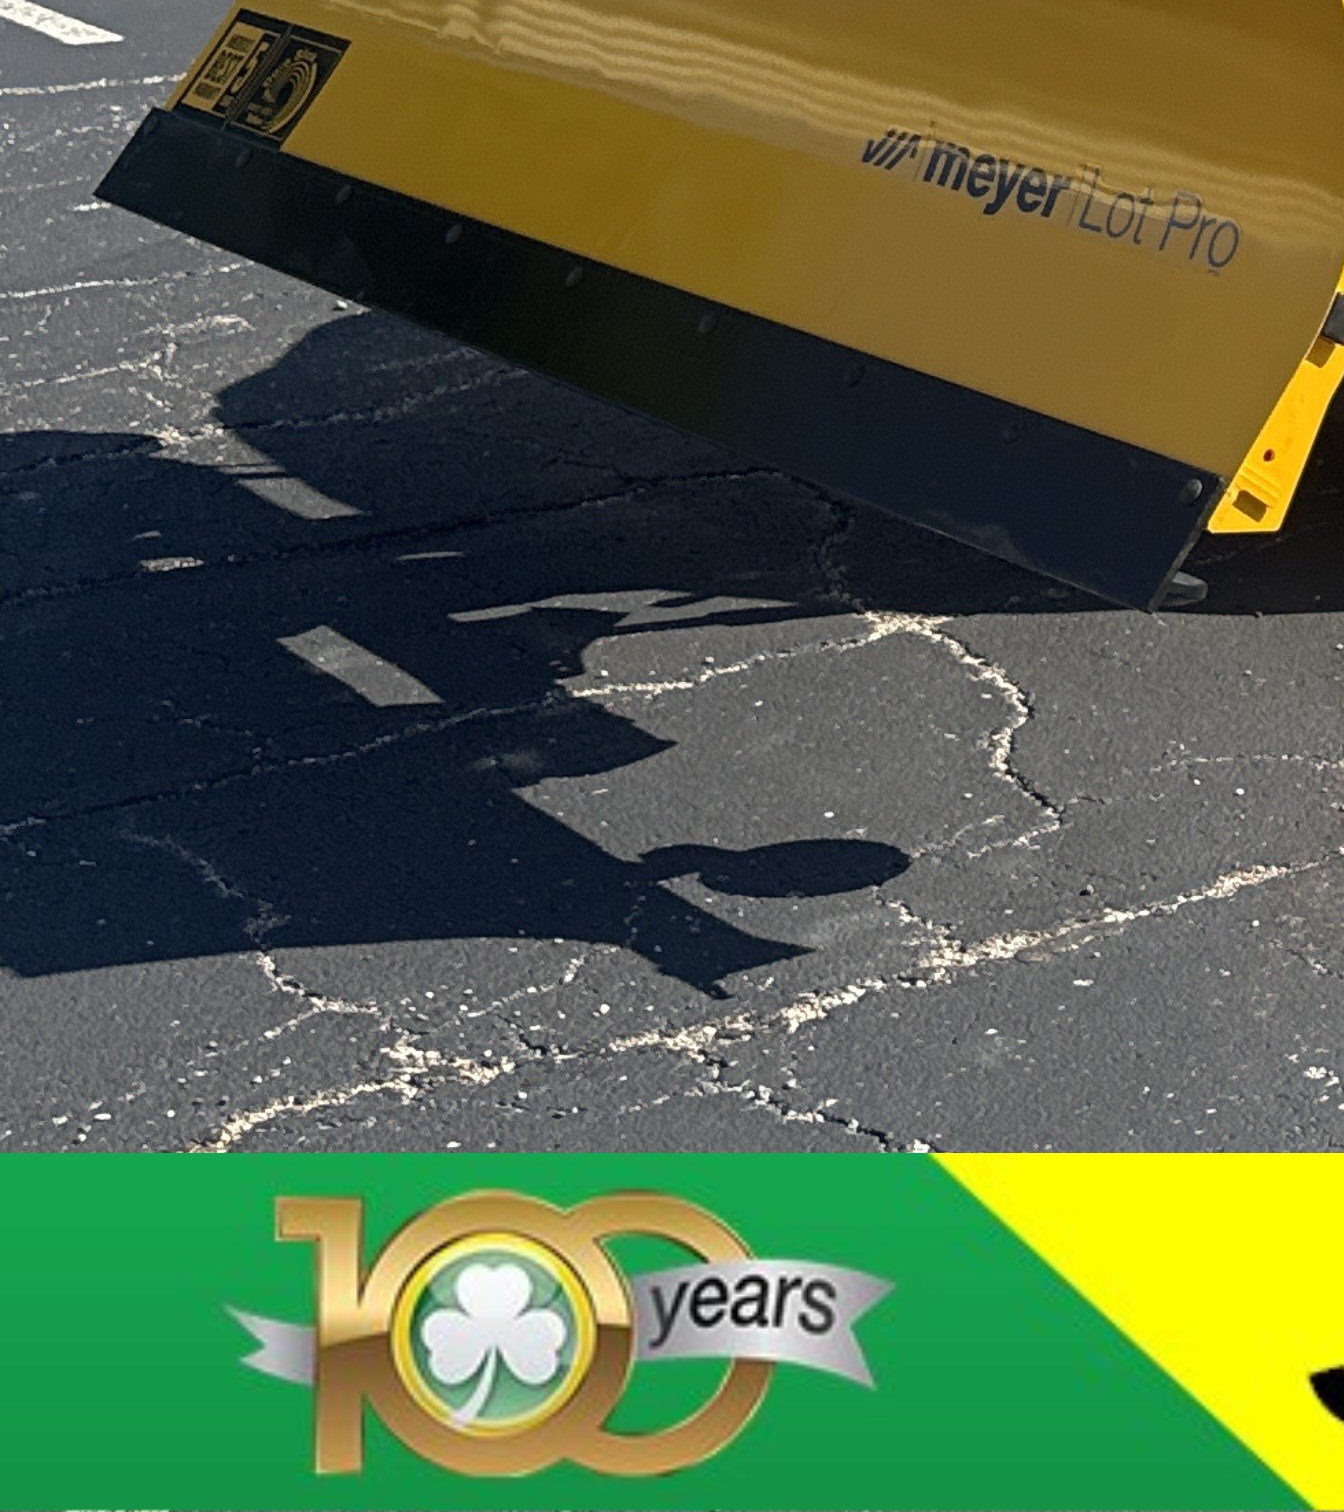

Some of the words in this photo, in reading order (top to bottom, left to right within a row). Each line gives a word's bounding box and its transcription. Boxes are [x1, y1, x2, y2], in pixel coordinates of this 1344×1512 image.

[922, 140, 1072, 218] meyer
[1078, 174, 1153, 245] Lot
[1158, 191, 1240, 268] Pro
